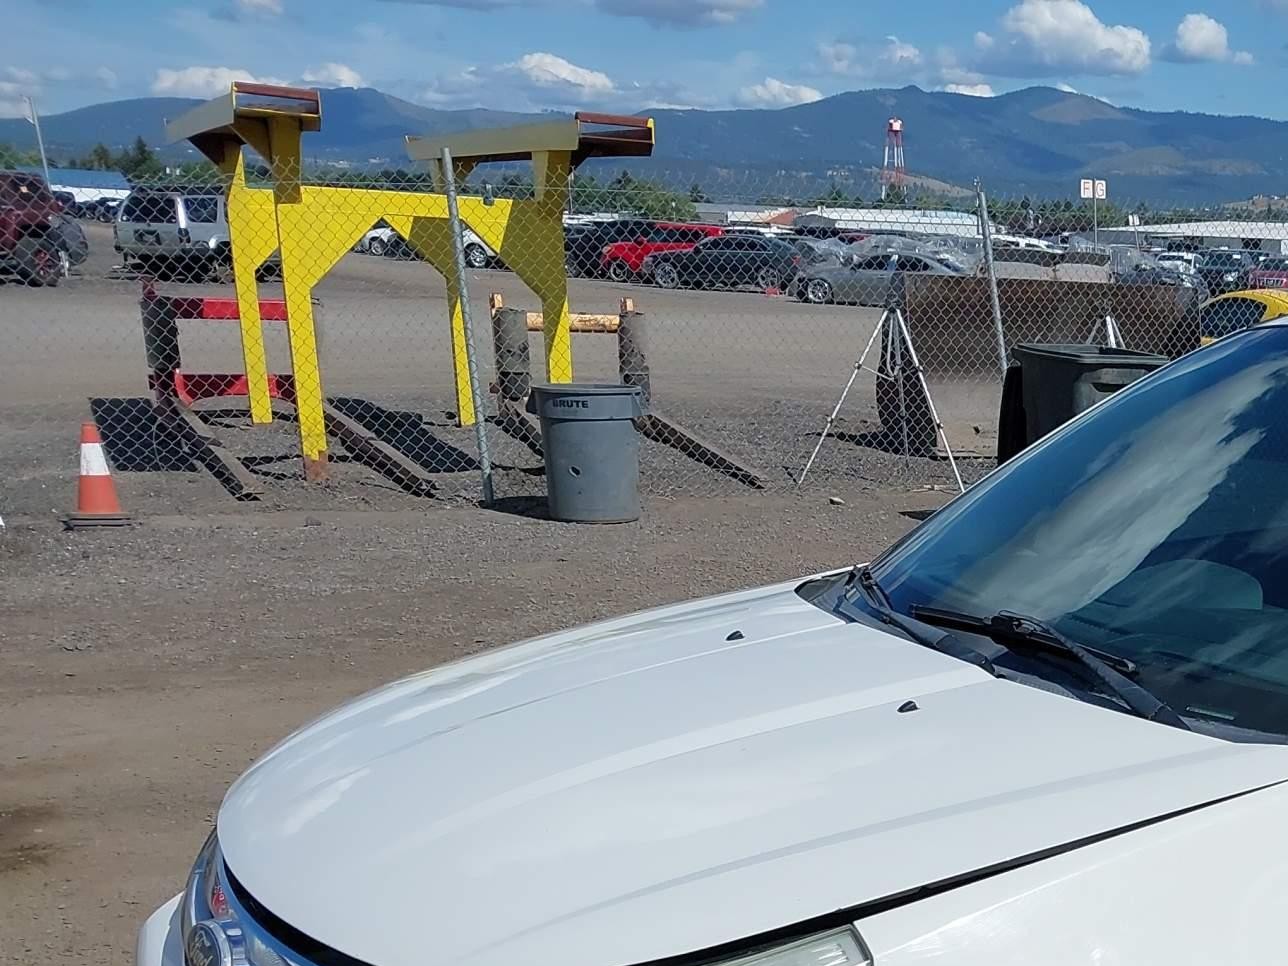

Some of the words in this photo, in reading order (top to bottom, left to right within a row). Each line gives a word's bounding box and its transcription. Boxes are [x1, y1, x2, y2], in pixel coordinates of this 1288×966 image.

[1083, 181, 1091, 197] F
[1096, 182, 1105, 197] G
[552, 400, 589, 409] BRUTE
